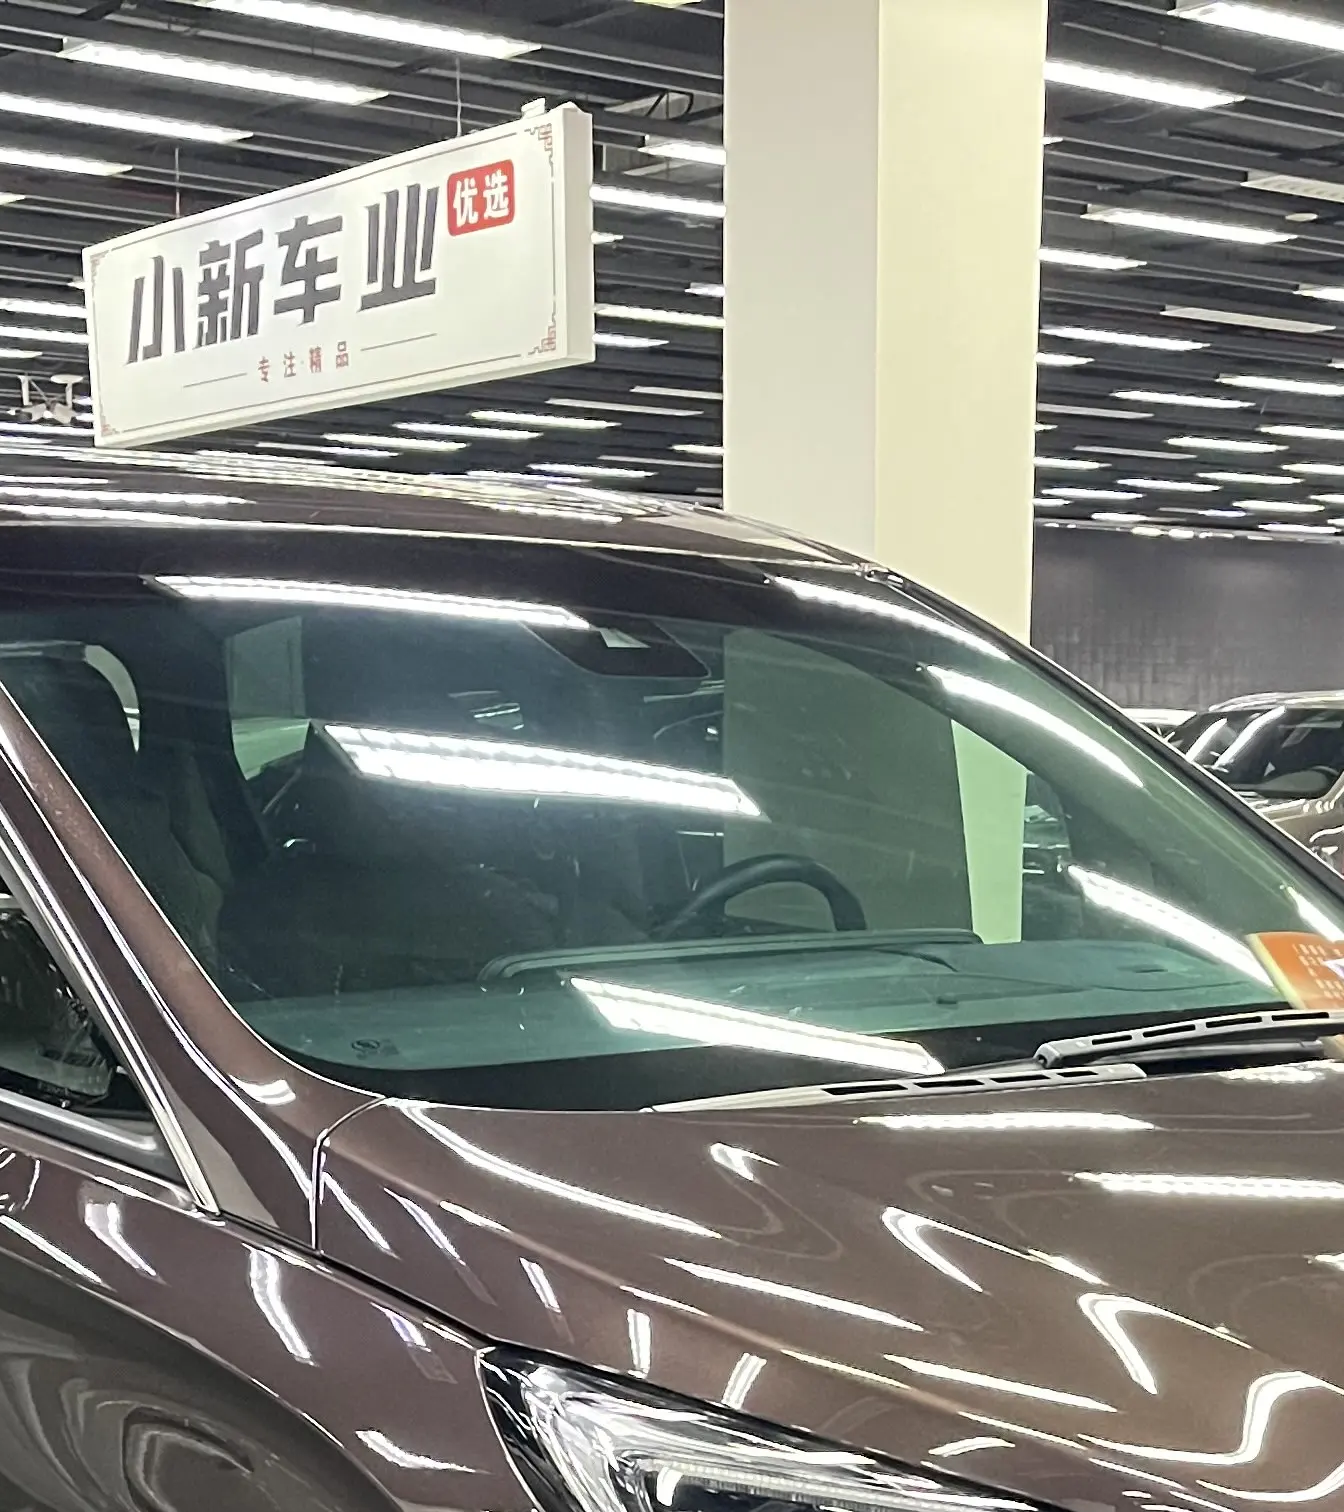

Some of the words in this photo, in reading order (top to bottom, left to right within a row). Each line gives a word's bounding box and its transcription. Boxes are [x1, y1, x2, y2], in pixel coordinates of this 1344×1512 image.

[452, 169, 511, 224] 优选
[125, 183, 440, 365] 小新车业
